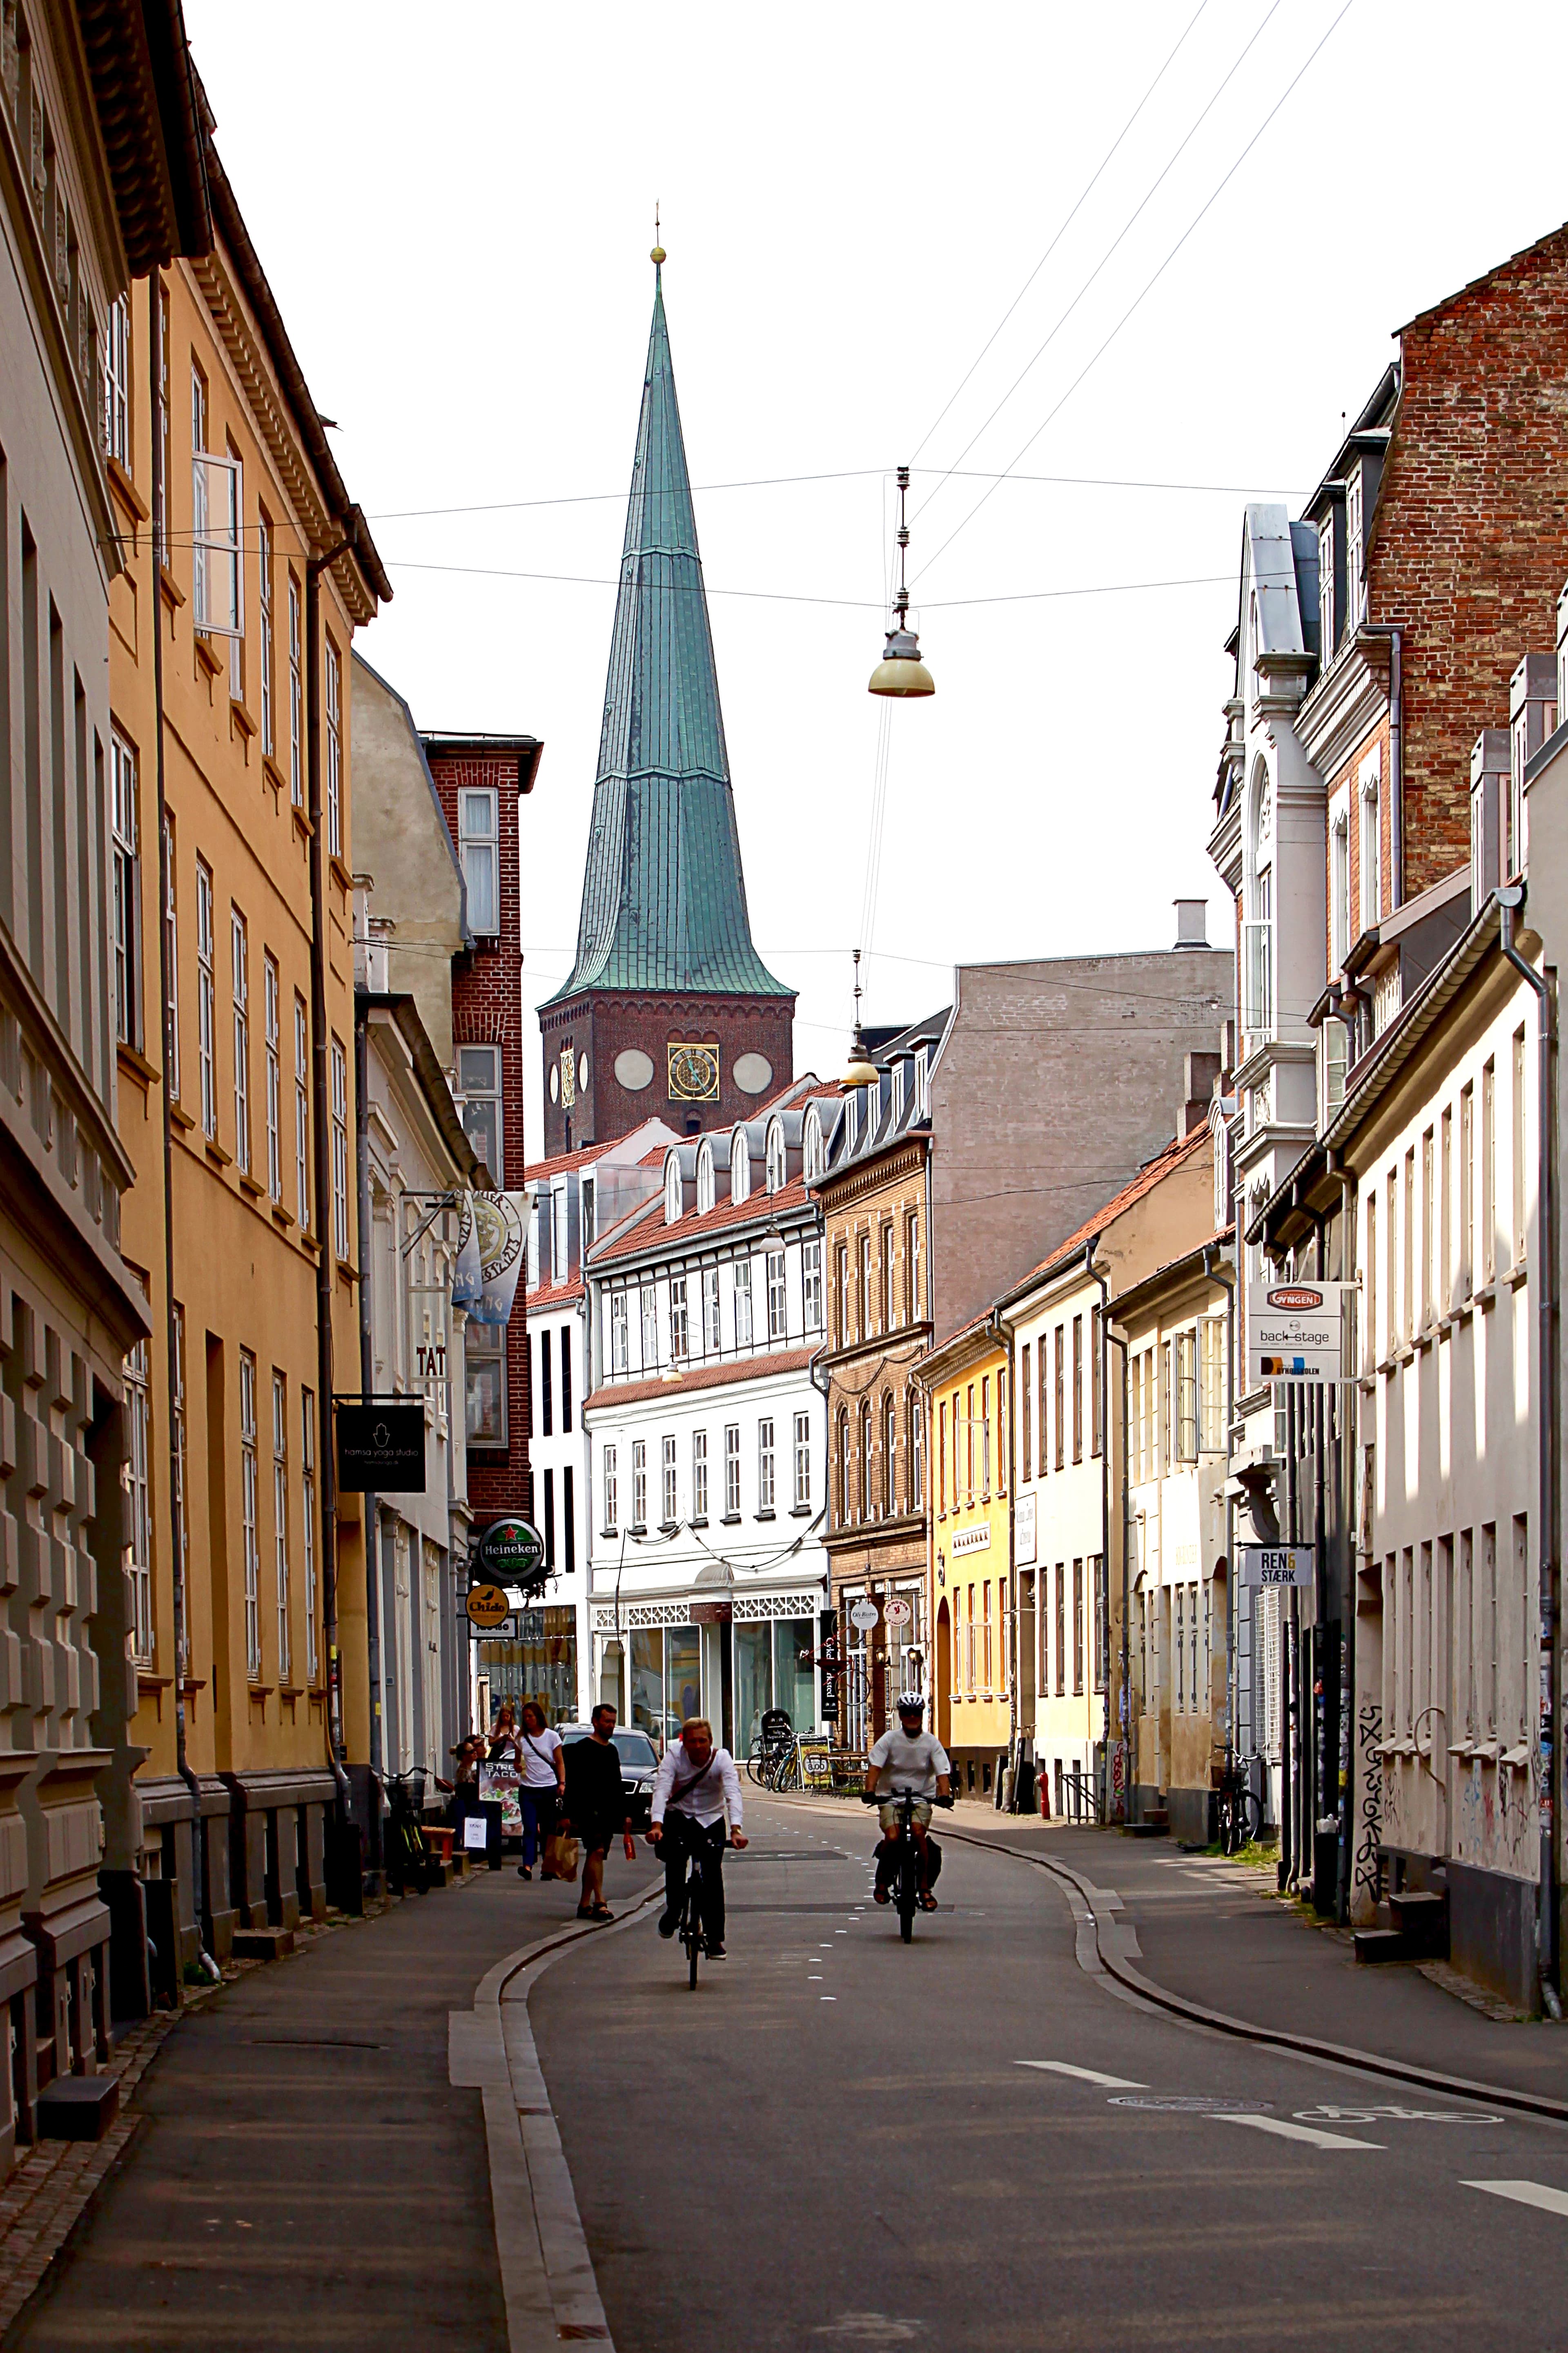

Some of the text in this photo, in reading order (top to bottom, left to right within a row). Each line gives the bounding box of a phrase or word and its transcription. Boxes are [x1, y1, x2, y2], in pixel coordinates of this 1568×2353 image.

[1272, 1292, 1314, 1304] GYNGEN
[416, 1346, 446, 1376] TAT
[374, 1450, 394, 1458] yoga
[485, 1544, 539, 1555] Heineken
[1261, 1570, 1295, 1582] STÆRK
[470, 1601, 505, 1612] Chido
